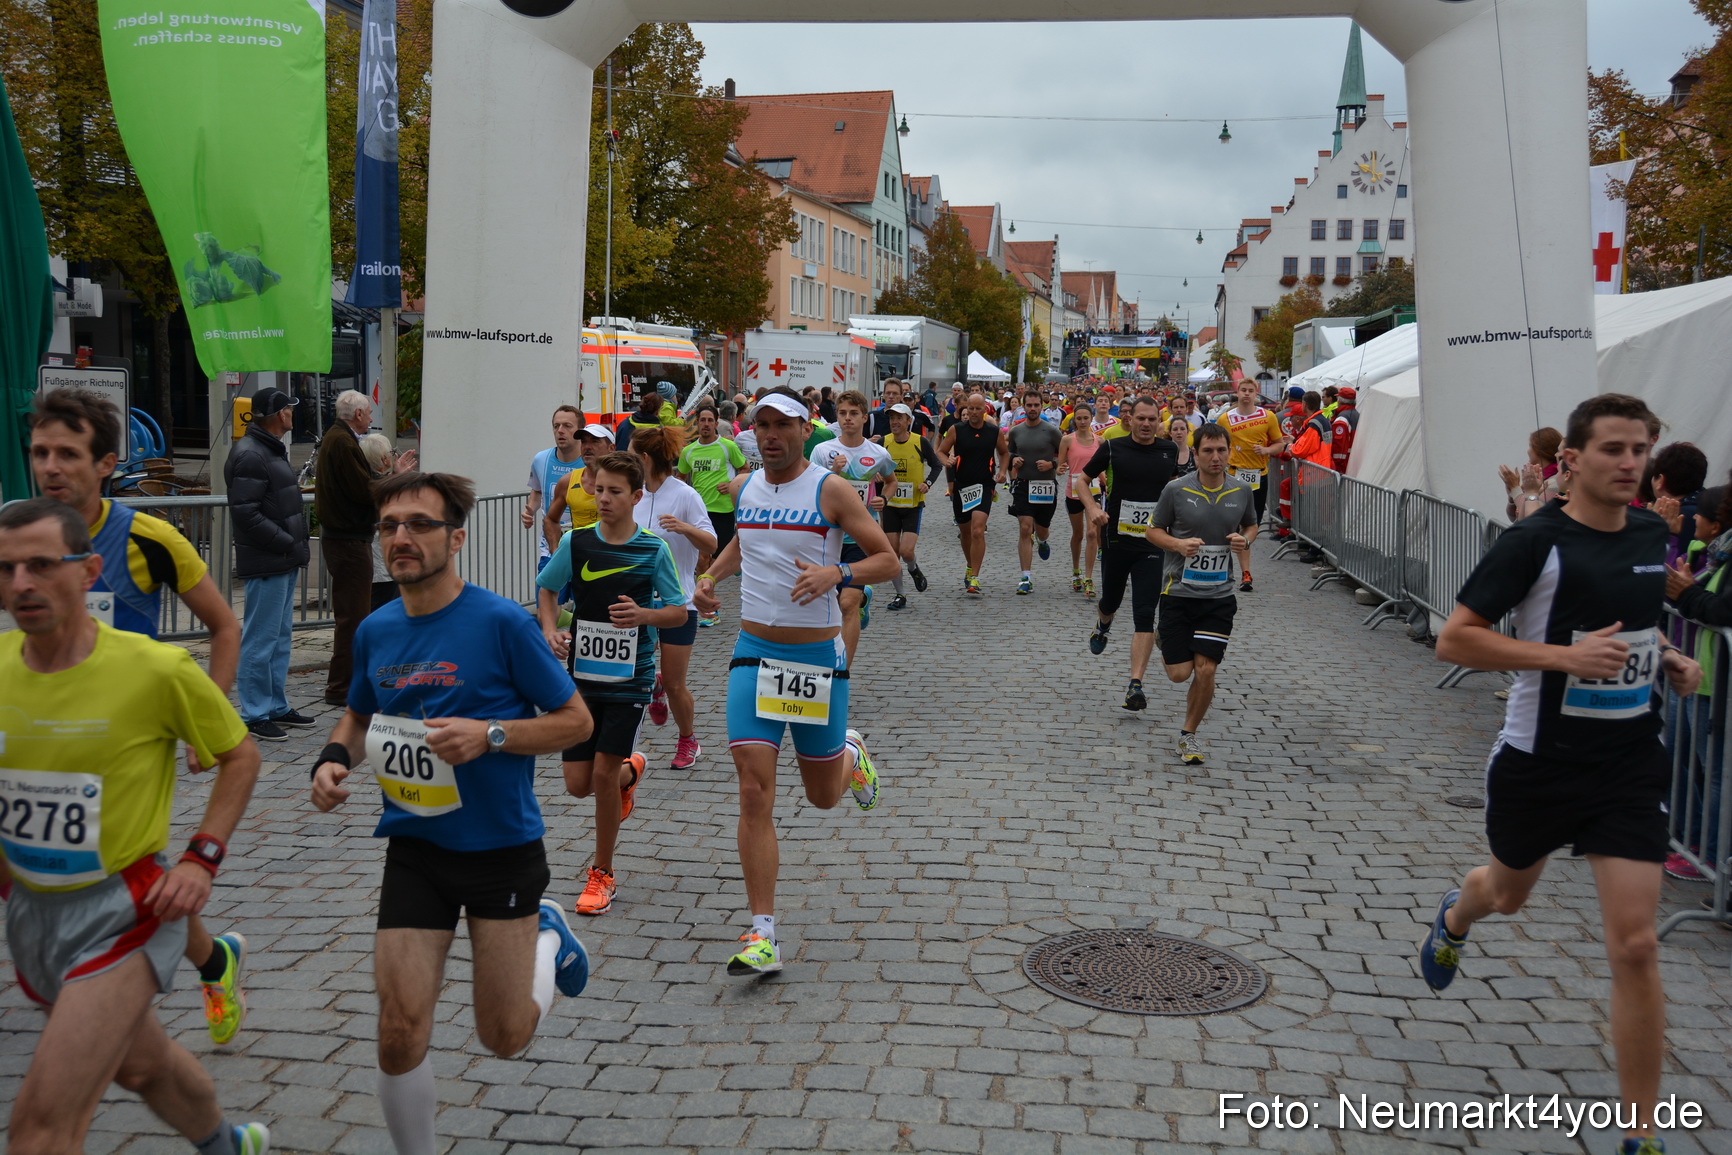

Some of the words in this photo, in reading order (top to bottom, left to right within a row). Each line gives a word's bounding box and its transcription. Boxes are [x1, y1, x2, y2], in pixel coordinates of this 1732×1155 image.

[360, 260, 401, 276] railon
[426, 327, 554, 345] www.bmw-laufsport.de
[1447, 326, 1593, 346] www.bmw-laufsport.de
[790, 358, 824, 367] Bayerisches
[44, 376, 88, 389] Fußgänger
[89, 378, 125, 389] Richtung
[1231, 424, 1248, 433] MAX
[1249, 419, 1269, 429] BÖGL
[694, 459, 712, 467] RUN
[1240, 473, 1257, 483] 358
[962, 489, 982, 503] 3097
[1031, 485, 1053, 495] 2611
[736, 506, 822, 526] cocoon
[1189, 554, 1227, 571] 2617
[577, 624, 595, 634] PARTL
[595, 627, 627, 637] Neumarkt
[580, 634, 631, 661] 3095
[394, 674, 457, 689] SORTS
[773, 672, 817, 699] 145
[1588, 692, 1639, 708] Dominik
[781, 702, 804, 716] Toby
[370, 723, 398, 736] PARTL
[382, 740, 435, 781] 206
[16, 782, 78, 796] Neumarkt
[399, 785, 421, 803] Karl
[0, 796, 86, 845] 2278
